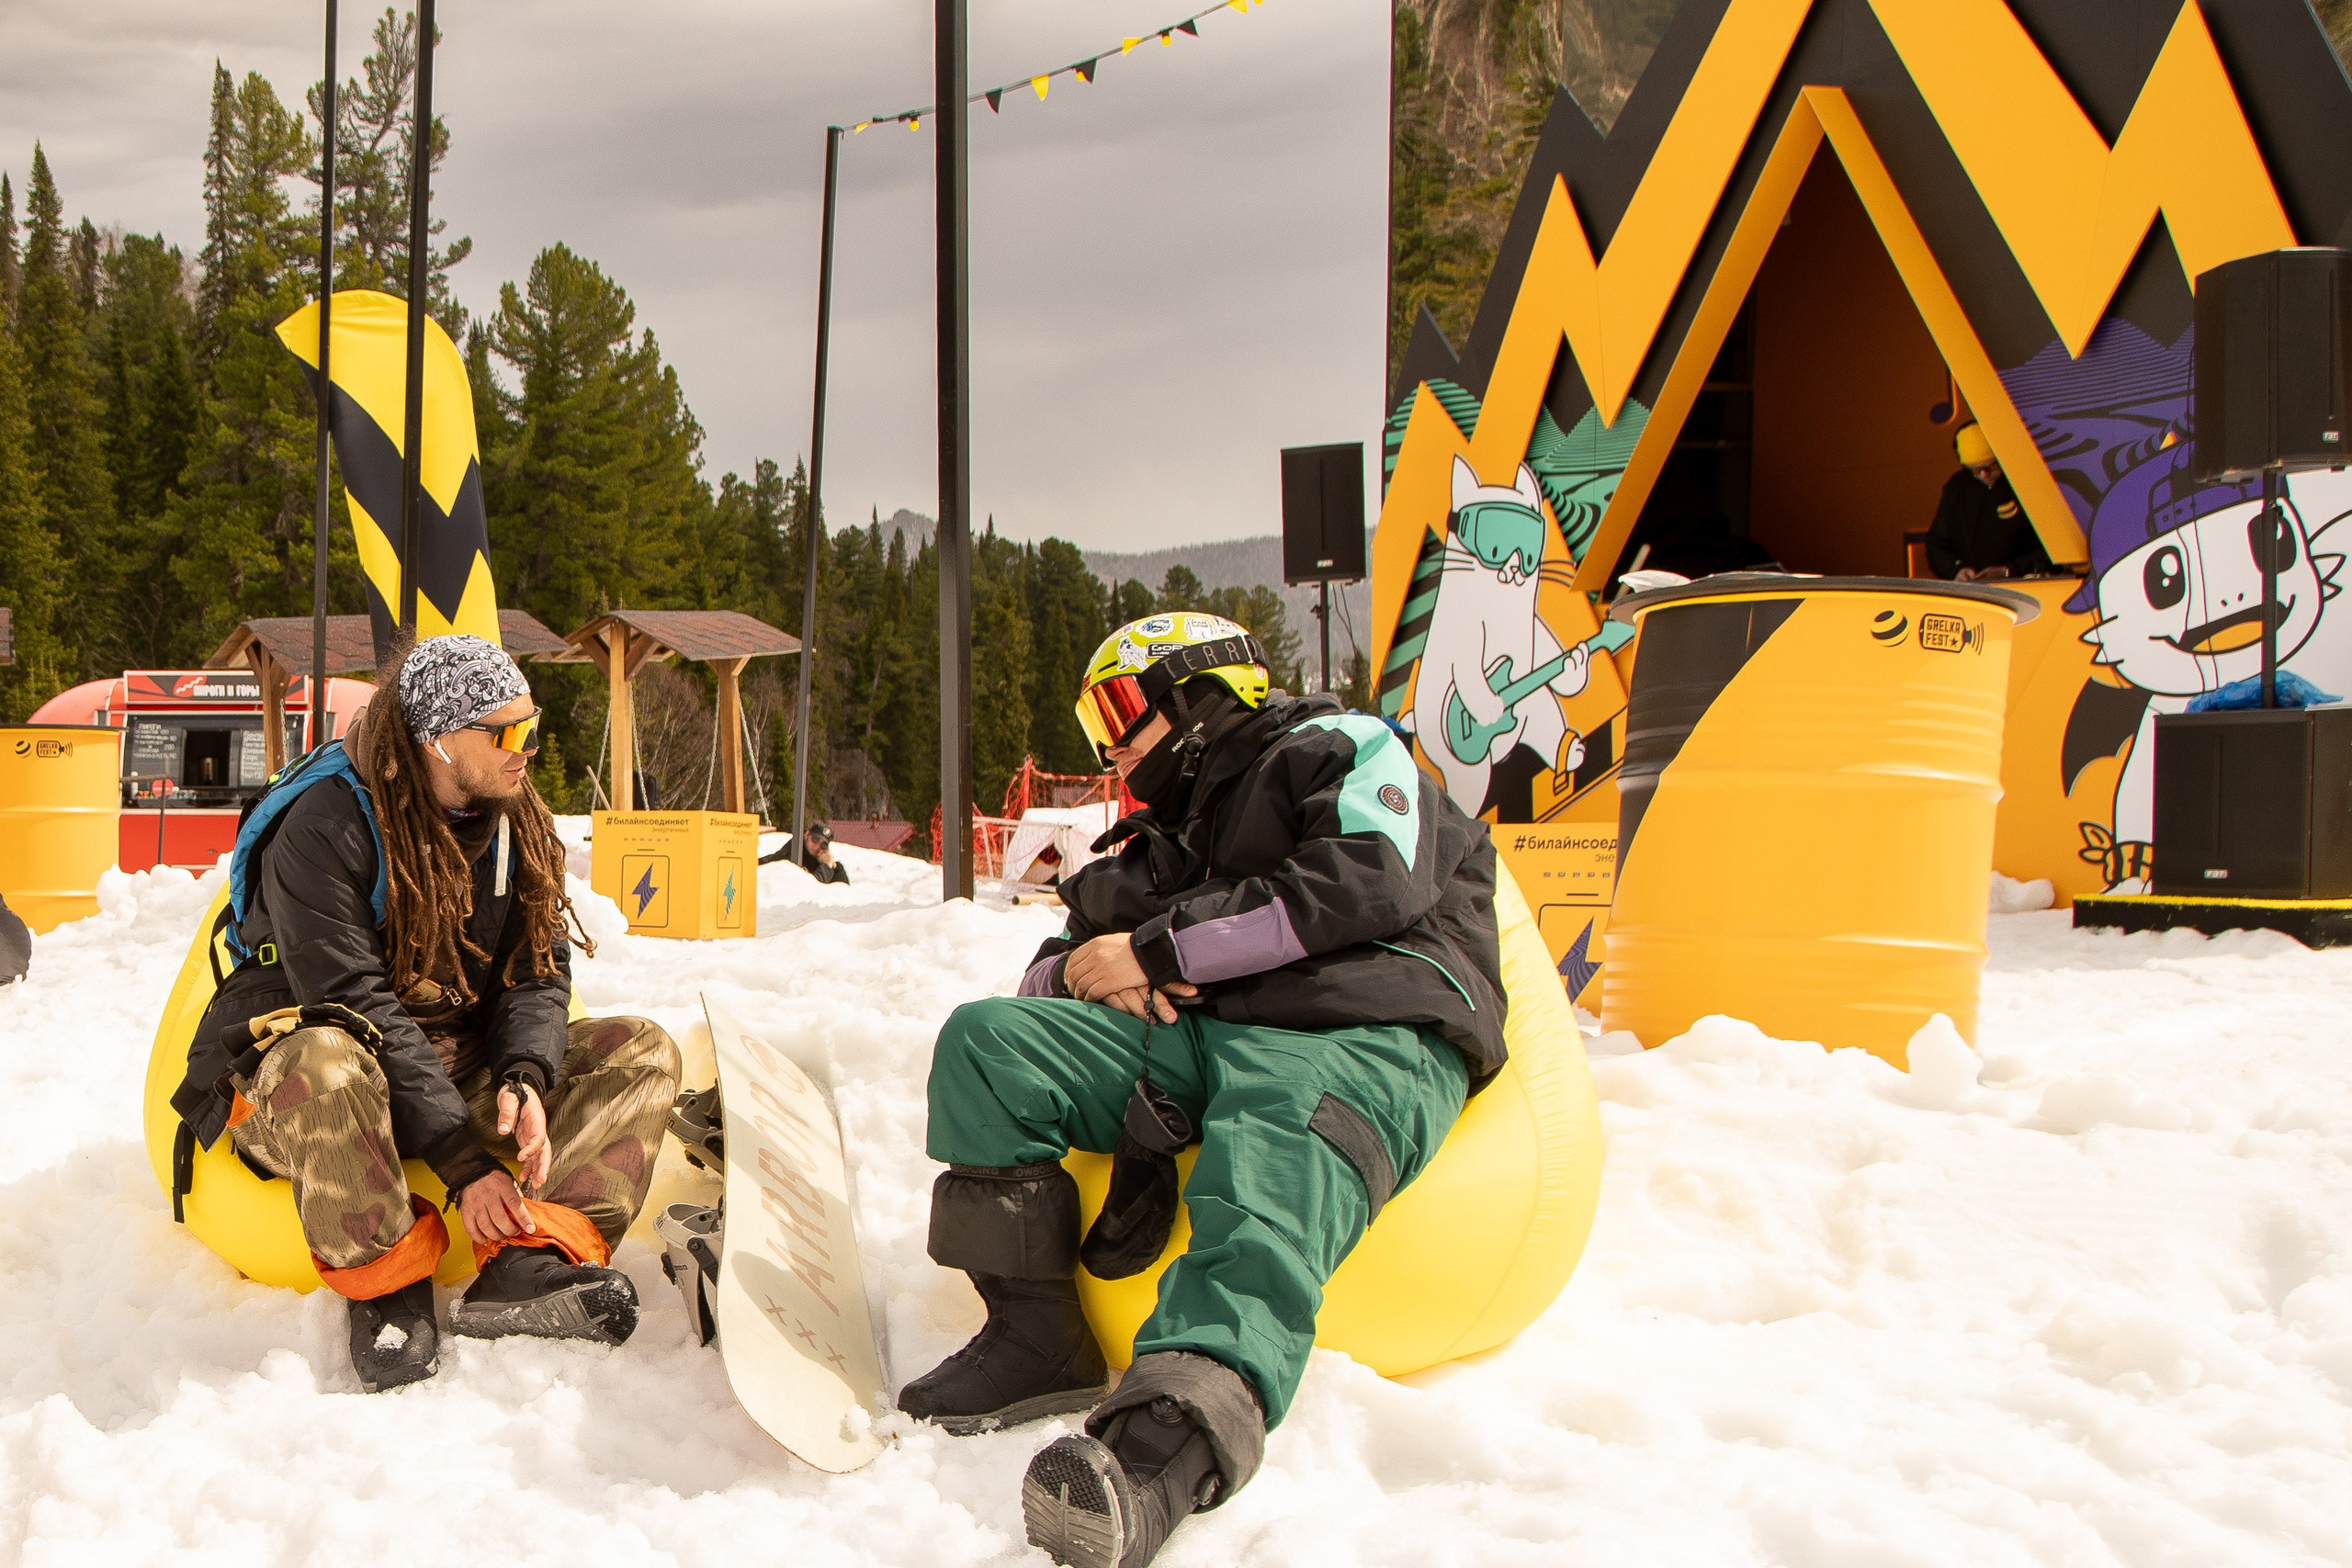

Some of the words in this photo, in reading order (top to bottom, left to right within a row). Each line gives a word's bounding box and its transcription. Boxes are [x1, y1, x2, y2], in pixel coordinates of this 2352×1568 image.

[1927, 618, 1961, 634] GRELKA
[1926, 633, 1950, 646] FEST
[194, 685, 225, 696] ПИРОГИ
[236, 684, 260, 696] ГОРЫ
[605, 817, 689, 826] #билайнсоединяет
[1514, 835, 1617, 852] #билайнсоед
[750, 1081, 840, 1316] ARBOR
